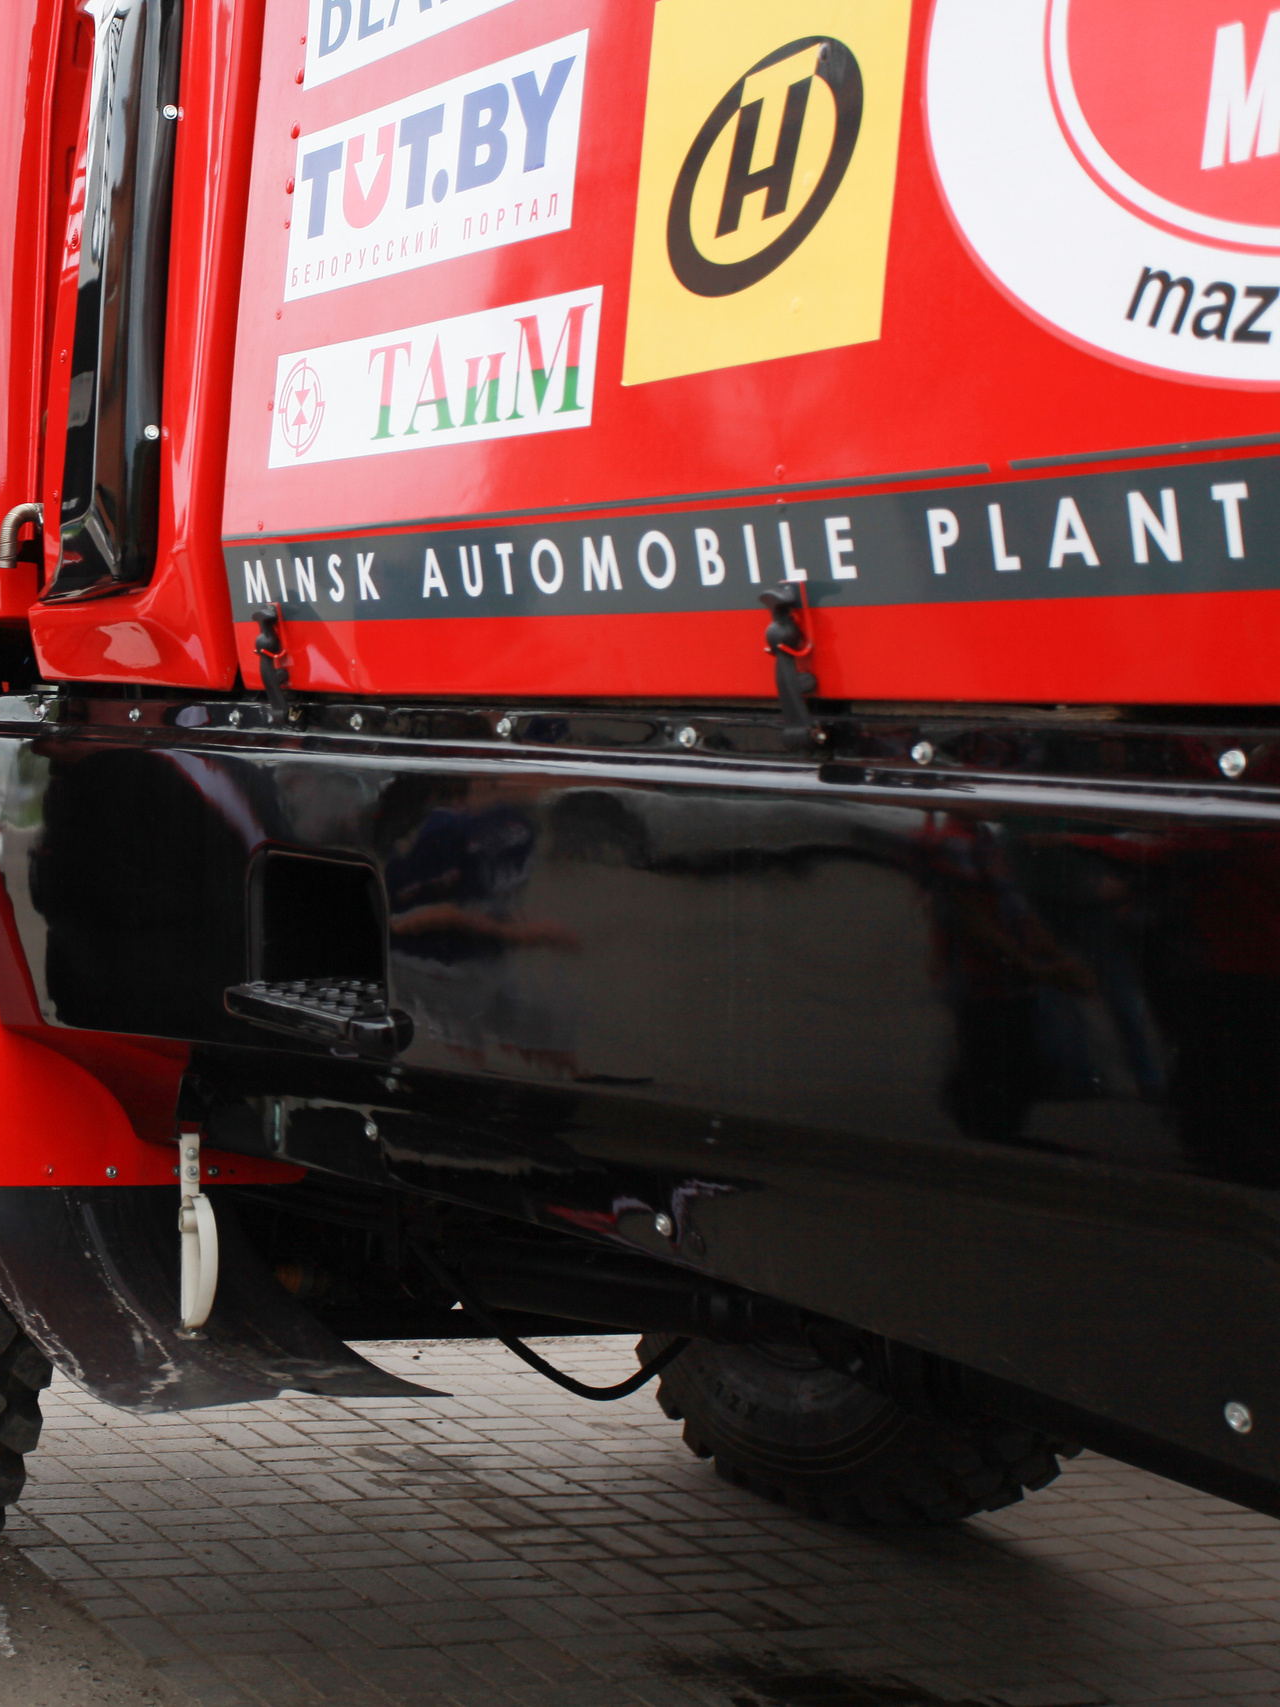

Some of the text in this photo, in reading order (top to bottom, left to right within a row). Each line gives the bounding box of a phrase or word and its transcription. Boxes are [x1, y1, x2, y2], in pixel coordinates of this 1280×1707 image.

[301, 55, 577, 239] TUT.BY
[291, 193, 559, 288] БЕЛОРУССКИЙ ПОРТАЛ
[244, 482, 1248, 603] MINSK AUTOMOBILE PLANT
